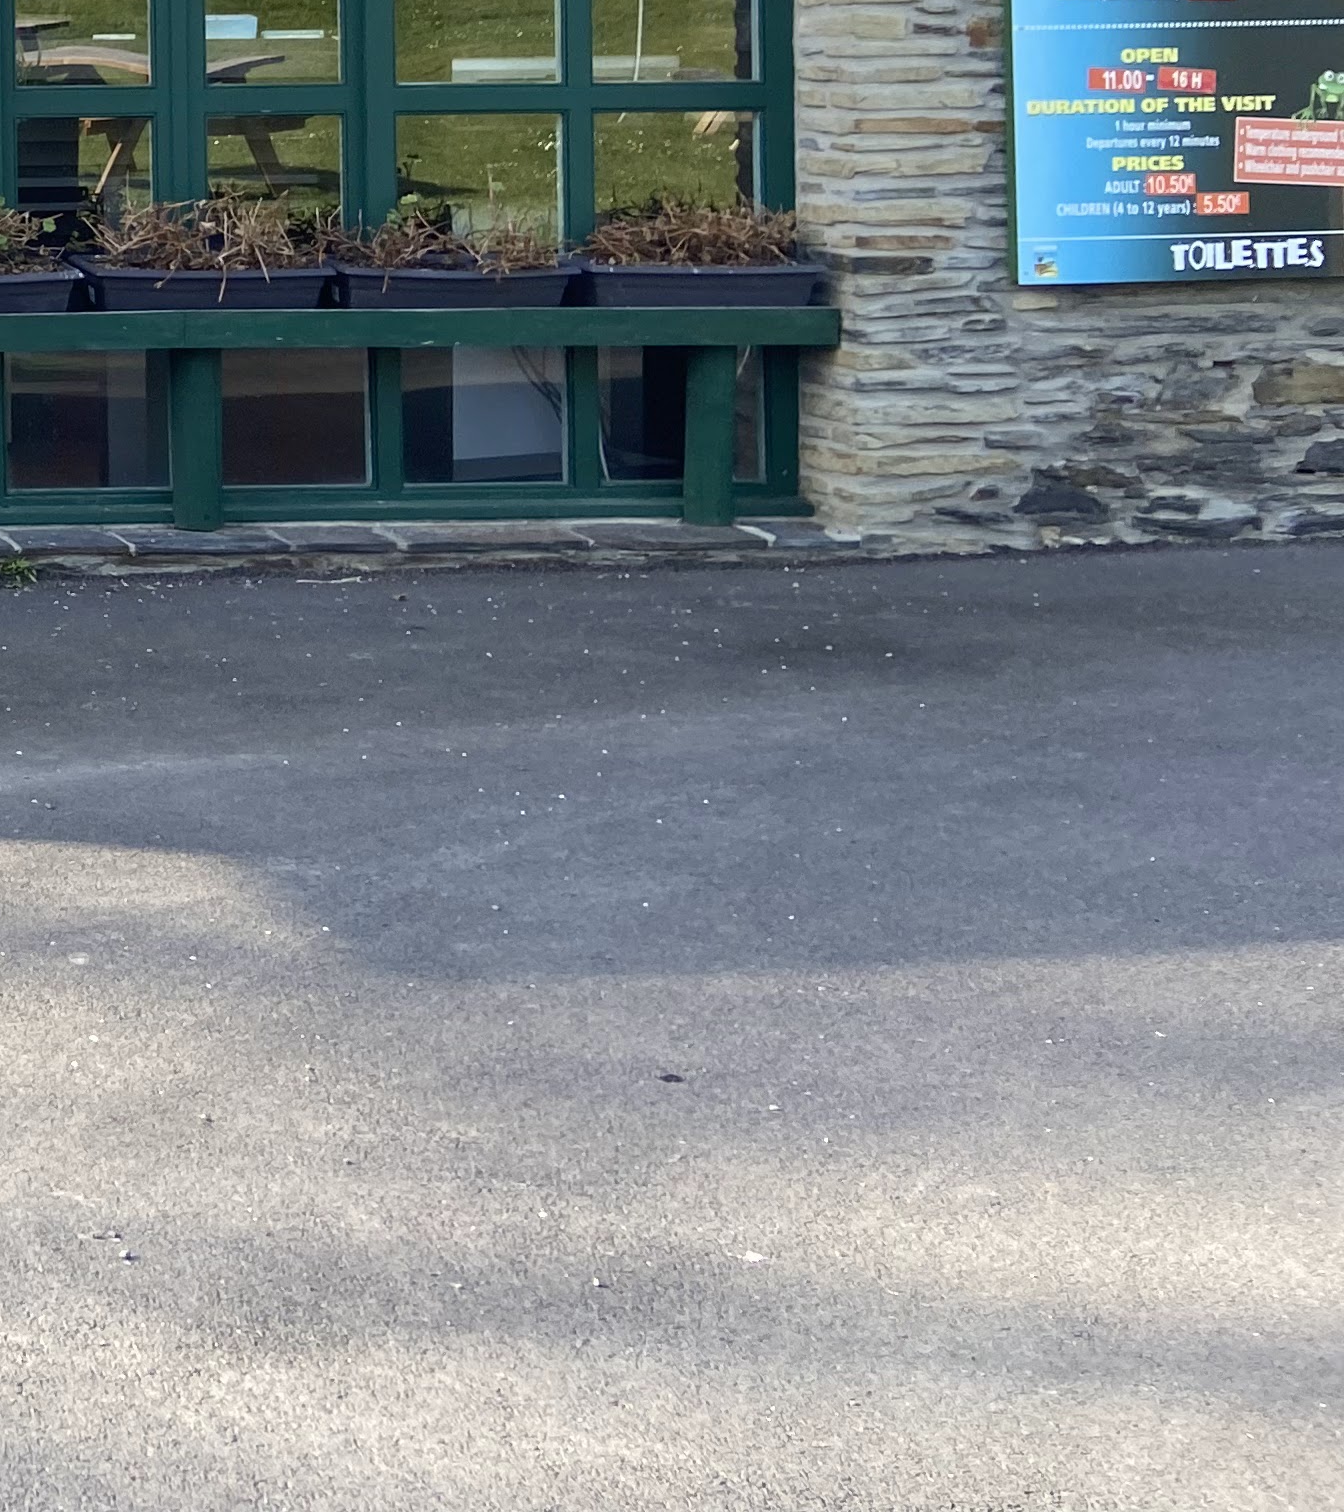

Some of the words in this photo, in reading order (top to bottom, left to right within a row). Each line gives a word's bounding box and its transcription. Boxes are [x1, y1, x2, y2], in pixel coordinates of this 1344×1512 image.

[1120, 47, 1179, 64] OPEN
[1101, 70, 1142, 91] 11.00
[1171, 69, 1187, 89] 16
[1191, 71, 1203, 90] H
[1026, 98, 1136, 116] DURATION
[1140, 97, 1169, 113] OF
[1174, 96, 1216, 113] THE
[1219, 95, 1276, 112] VISIT
[1139, 137, 1167, 150] every
[1169, 135, 1181, 148] 12
[1112, 155, 1185, 172] PRICES
[1104, 180, 1141, 195] ADULT
[1055, 201, 1111, 217] CHILDREN
[1113, 201, 1125, 217] (4
[1126, 201, 1139, 215] to
[1142, 201, 1155, 215] 12
[1157, 199, 1191, 218] years)
[1169, 237, 1325, 272] TOILETTES
